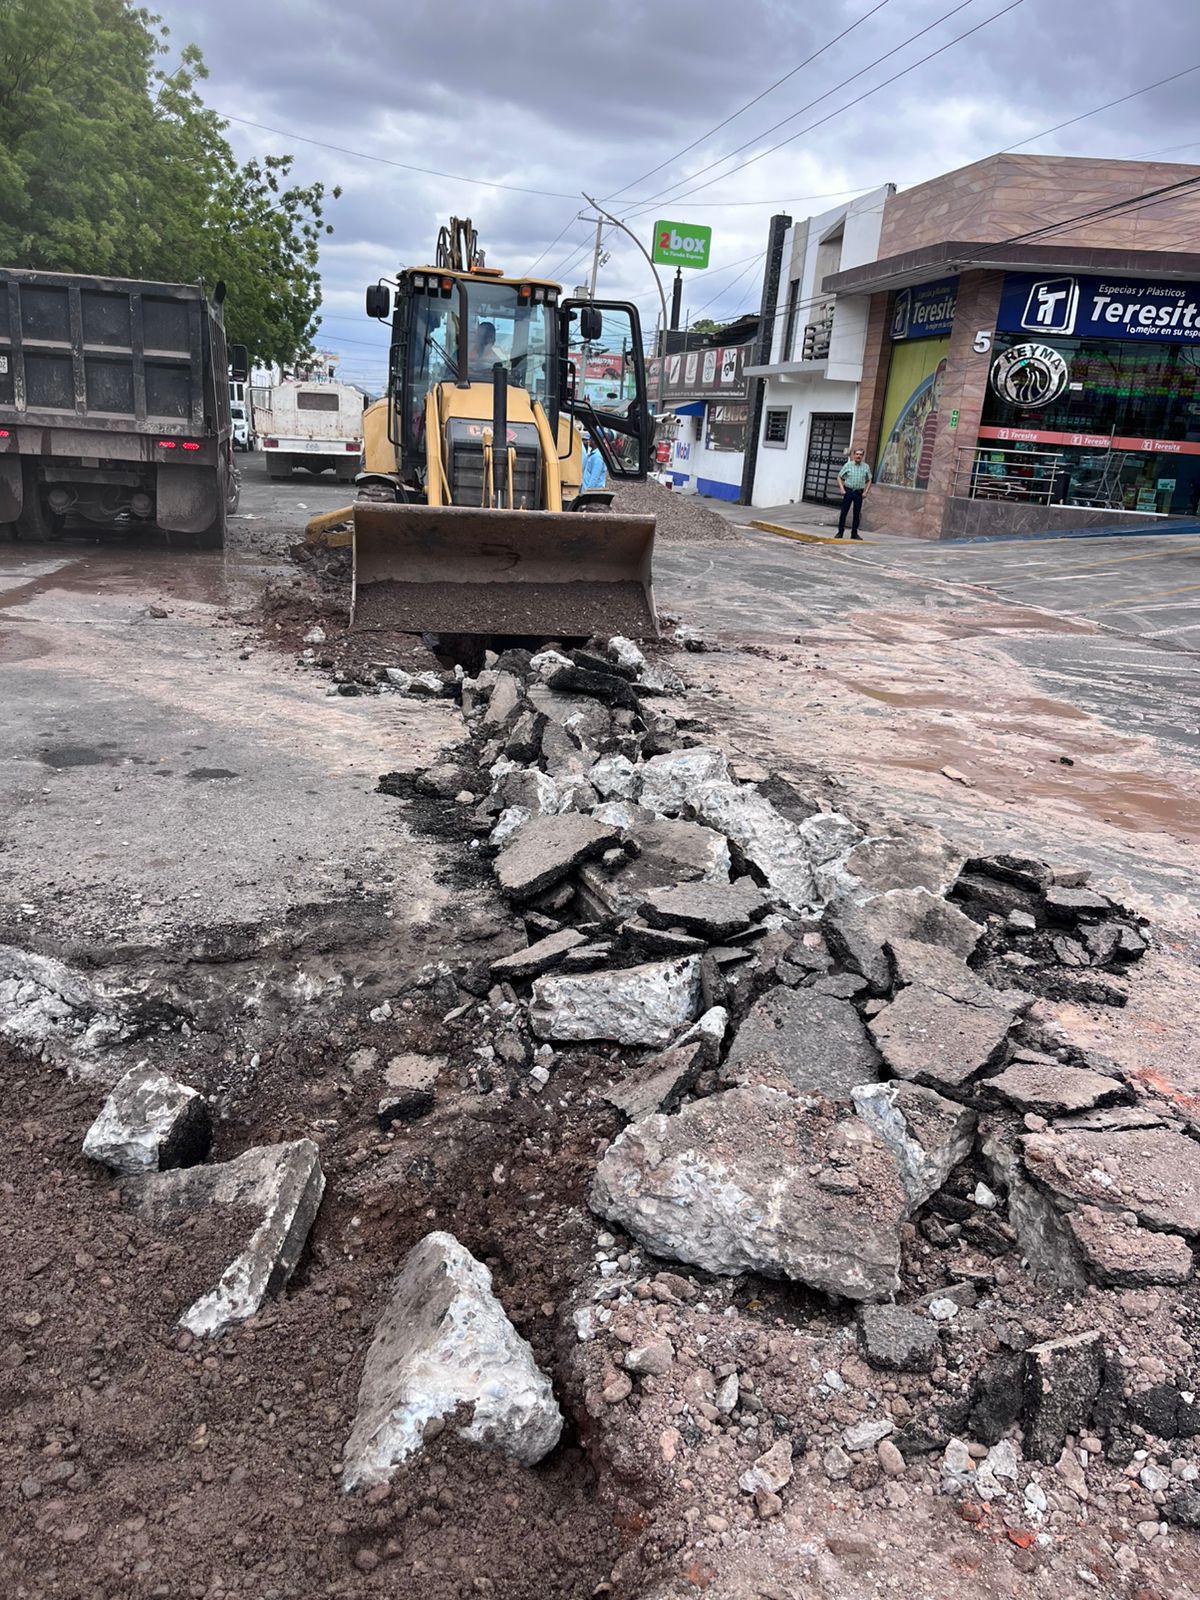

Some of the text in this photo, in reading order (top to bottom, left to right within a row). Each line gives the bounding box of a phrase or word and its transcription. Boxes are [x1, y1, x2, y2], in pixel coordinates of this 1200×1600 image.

[659, 229, 706, 253] 2box
[1099, 284, 1137, 295] Especias
[1137, 287, 1145, 297] y
[972, 330, 992, 354] 5
[1161, 328, 1172, 336] en
[1172, 328, 1183, 336] su
[1004, 343, 1064, 371] REYMA
